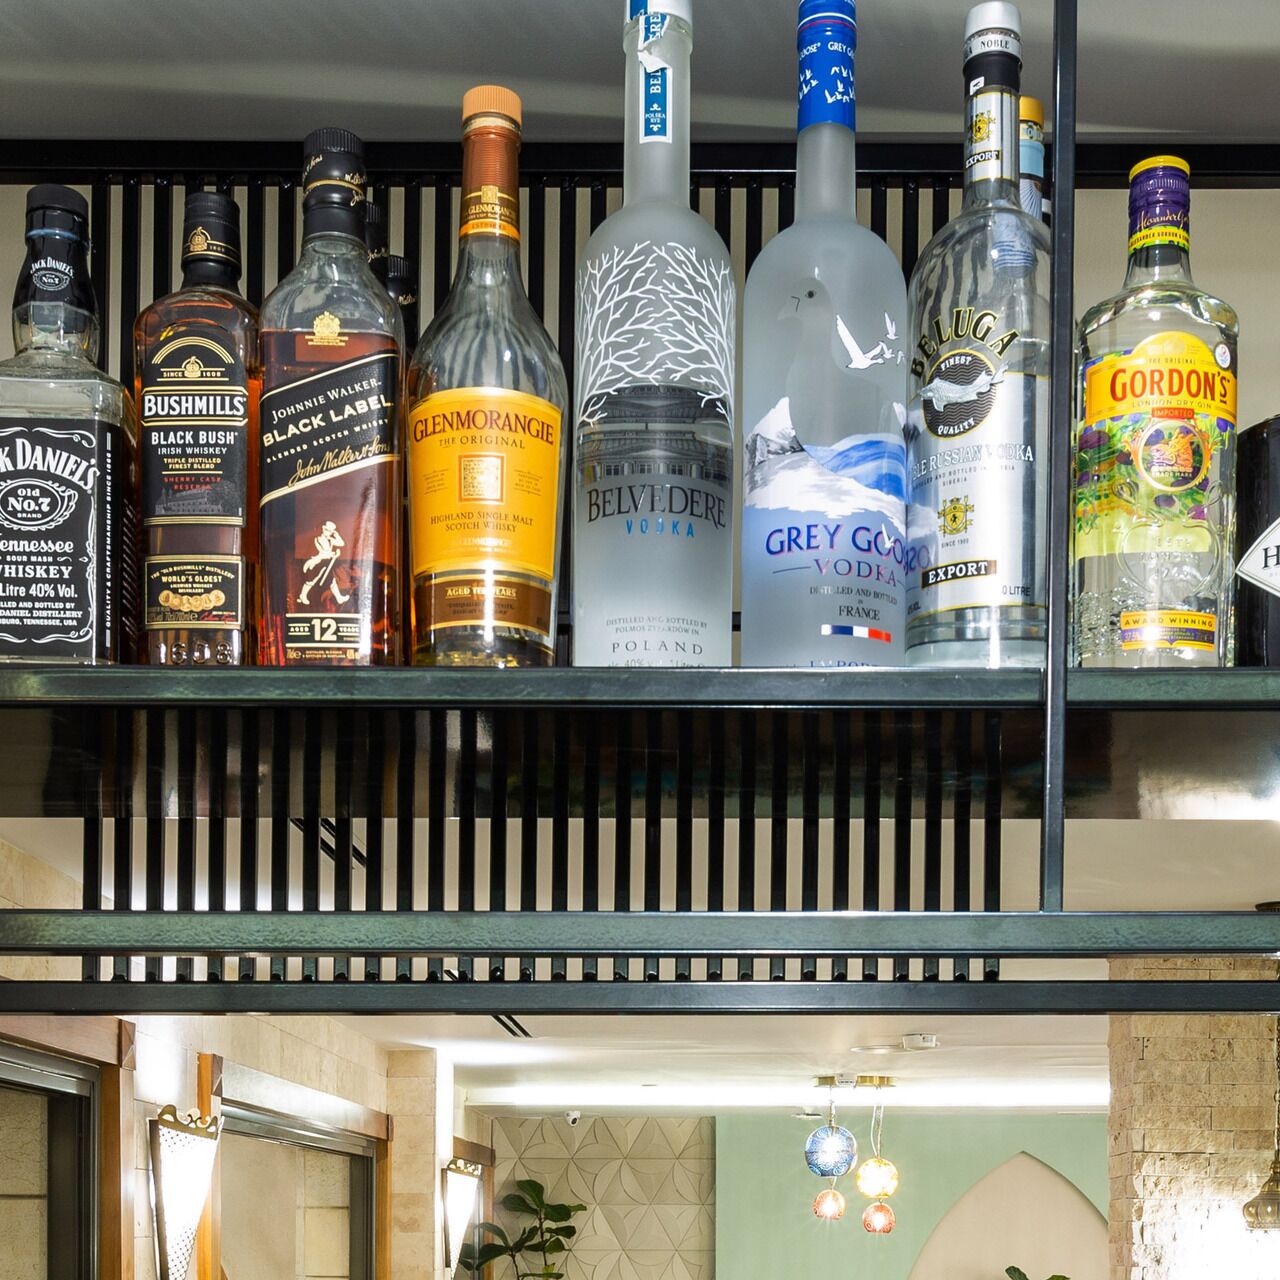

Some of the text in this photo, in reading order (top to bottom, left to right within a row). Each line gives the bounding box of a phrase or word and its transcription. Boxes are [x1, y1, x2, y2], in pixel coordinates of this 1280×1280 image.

[828, 41, 846, 53] GREY
[980, 39, 1010, 49] NOBLE
[965, 151, 998, 169] EXPORT
[30, 258, 46, 274] JACK
[910, 307, 1020, 379] BELUGA
[940, 356, 972, 371] FINEST
[1110, 368, 1228, 403] GORDON'S
[144, 395, 245, 417] BUSHMILLS
[272, 377, 377, 425] JOHNNIE WALKER
[1132, 399, 1172, 408] LONDON
[263, 394, 392, 447] BLACK LABEL
[1154, 408, 1193, 417] IMPORTED
[413, 409, 554, 446] GLENMORANGIE
[937, 417, 975, 435] QUALITY
[151, 431, 235, 445] BLACK BUSH
[266, 418, 389, 464] BLENDED SCOTCH WHISKY
[439, 435, 526, 449] THE ORIGINAL
[158, 447, 228, 455] IRISH WHISKEY
[929, 444, 983, 470] RUSSIAN
[15, 438, 101, 491] DANIEL'S
[17, 488, 41, 497] Old
[7, 496, 52, 513] No.7
[587, 483, 727, 530] BELVEDERE
[430, 510, 534, 527] HIGHLAND SINGLE MALT
[445, 521, 518, 533] SCOTCH WHISKY
[625, 518, 695, 538] VODKA
[765, 523, 842, 557] GREY
[161, 575, 193, 583] WORLD'S
[813, 557, 897, 587] VODKA
[928, 561, 988, 584] EXPORT
[0, 582, 78, 598] Litre 40% Vol.
[446, 587, 471, 597] AGED
[855, 586, 872, 597] AND
[1008, 585, 1031, 597] LITRE
[34, 601, 64, 609] BOTTLED
[838, 604, 880, 622] FRANCE
[0, 609, 31, 617] DANIEL
[33, 610, 83, 618] DISTILLERY
[23, 618, 78, 627] TENNESSEE, USA
[311, 618, 338, 641] 12
[1124, 617, 1213, 627] AWARD WINNING
[612, 639, 704, 655] POLAND
